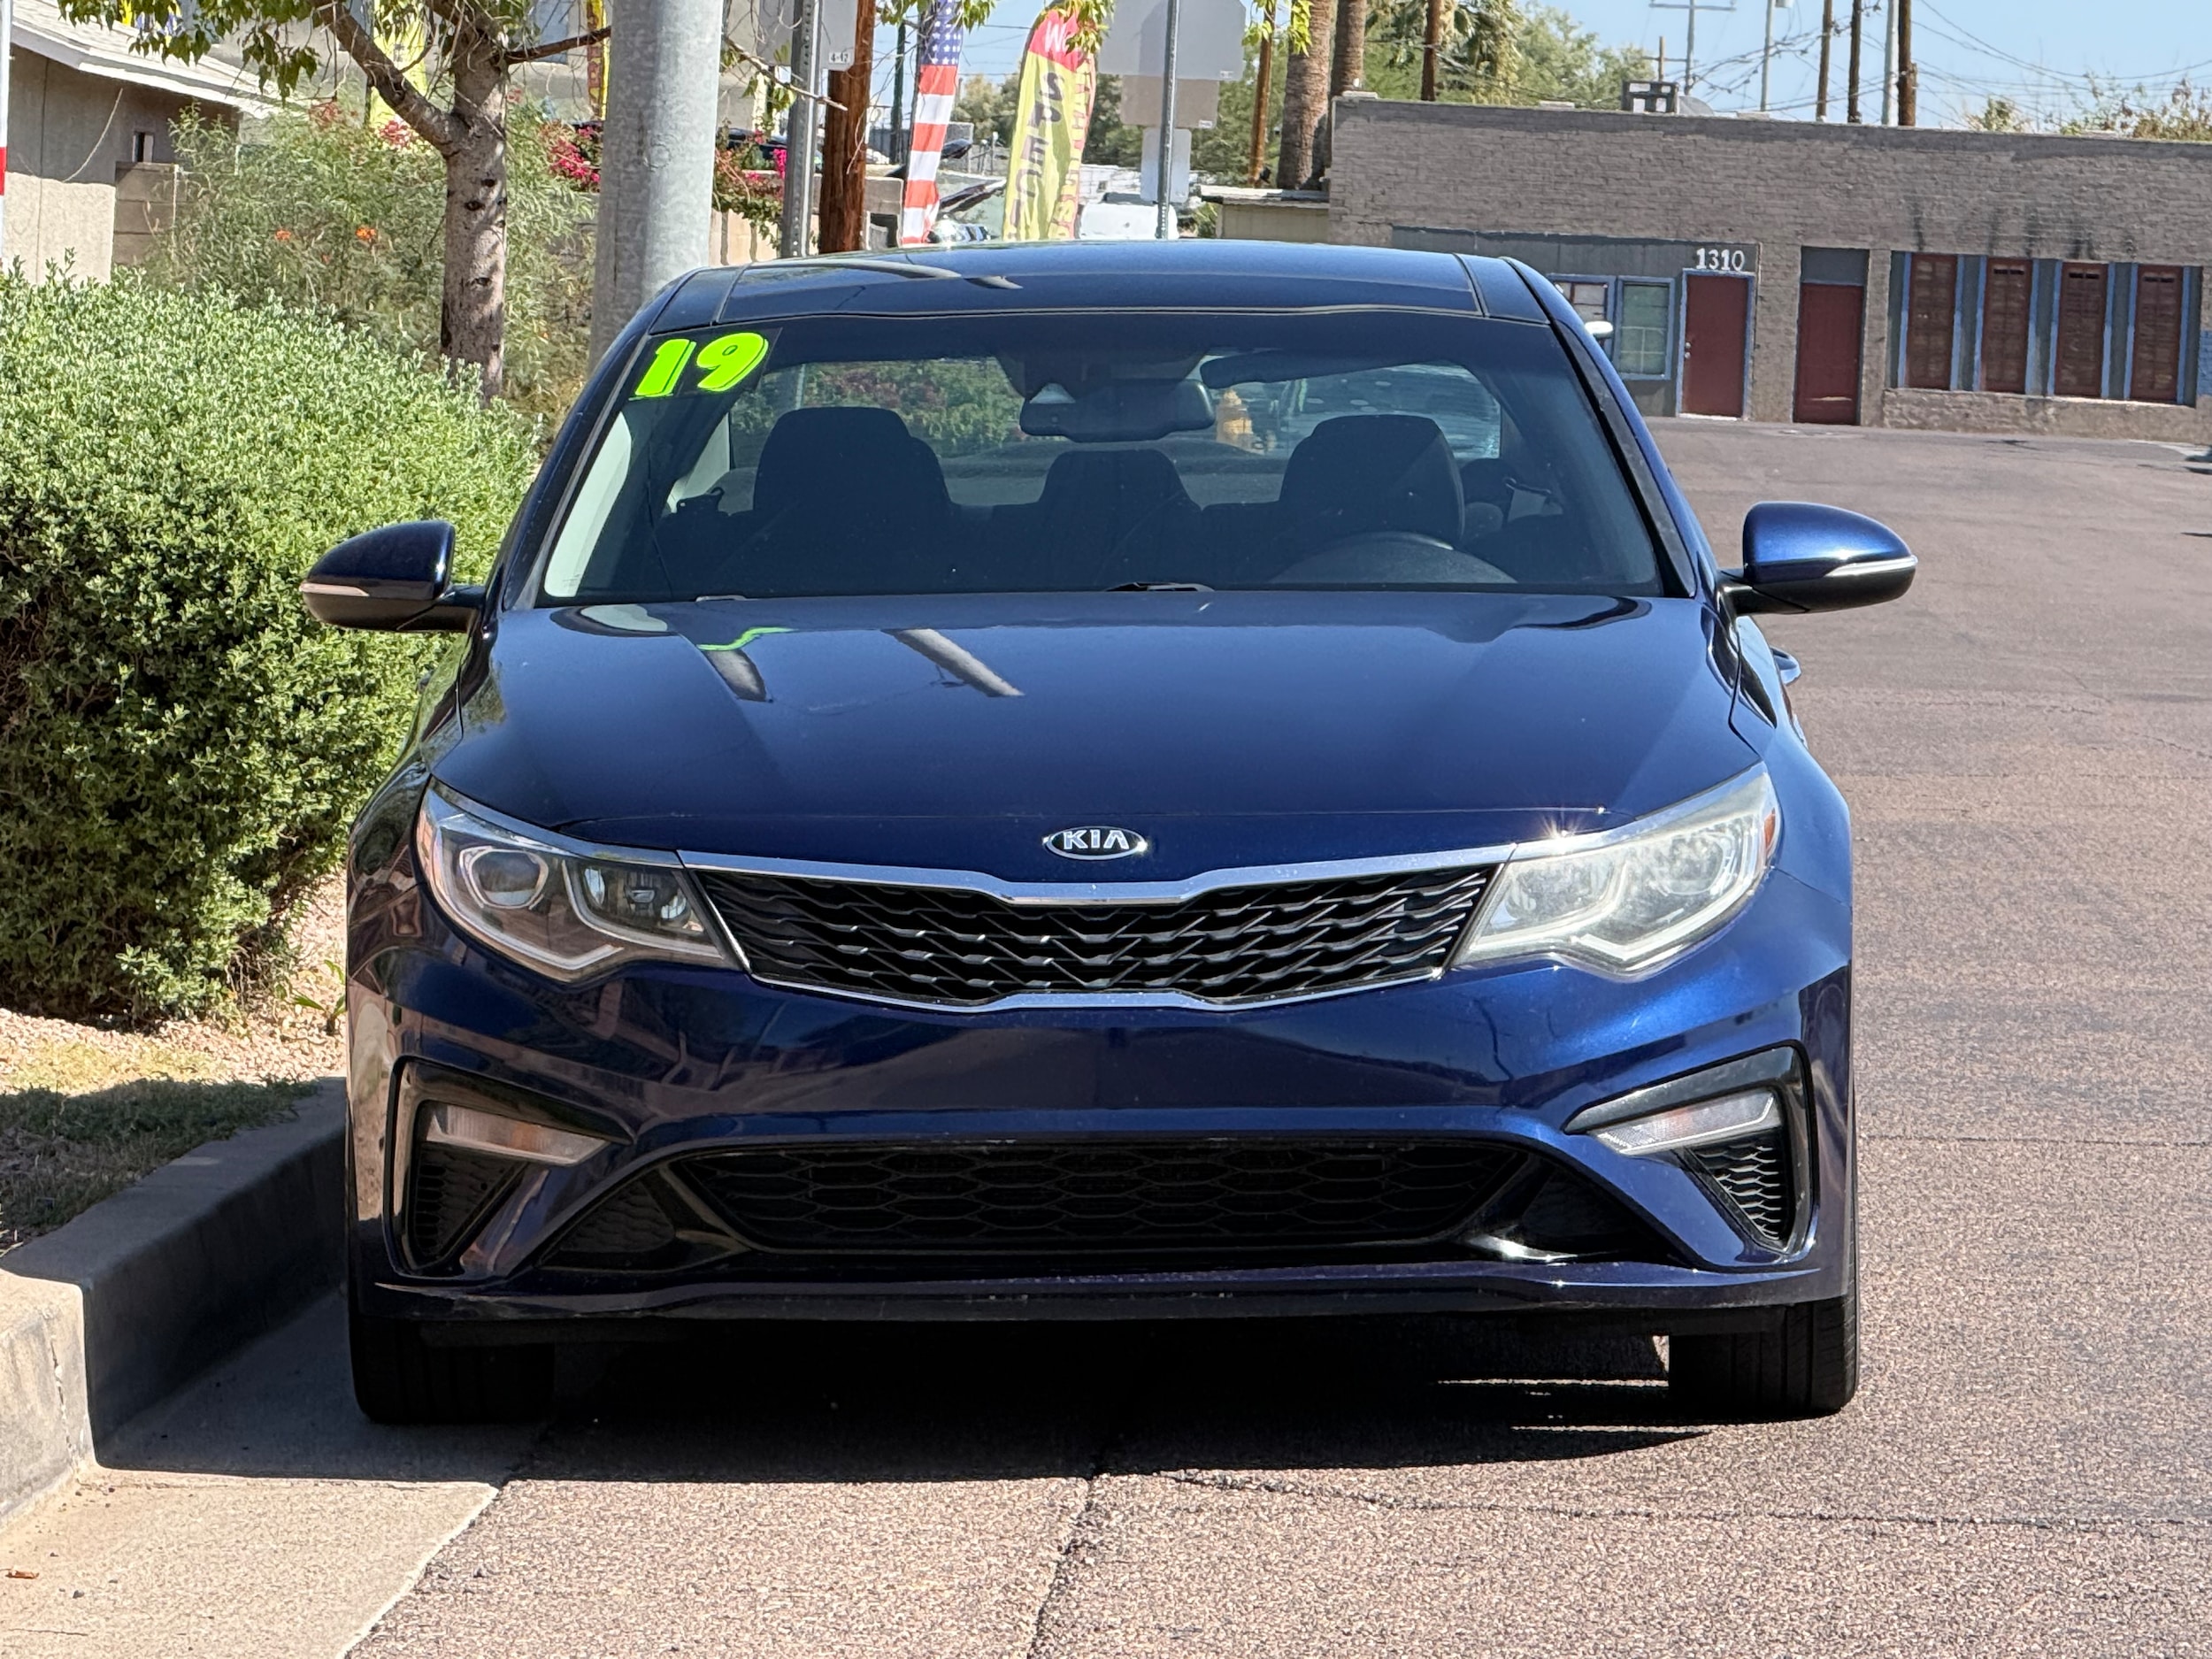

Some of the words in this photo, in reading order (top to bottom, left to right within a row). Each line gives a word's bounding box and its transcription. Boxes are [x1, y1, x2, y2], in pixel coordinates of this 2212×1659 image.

[1695, 247, 1746, 272] 1310
[633, 331, 769, 398] 19
[1063, 829, 1130, 850] KIA
